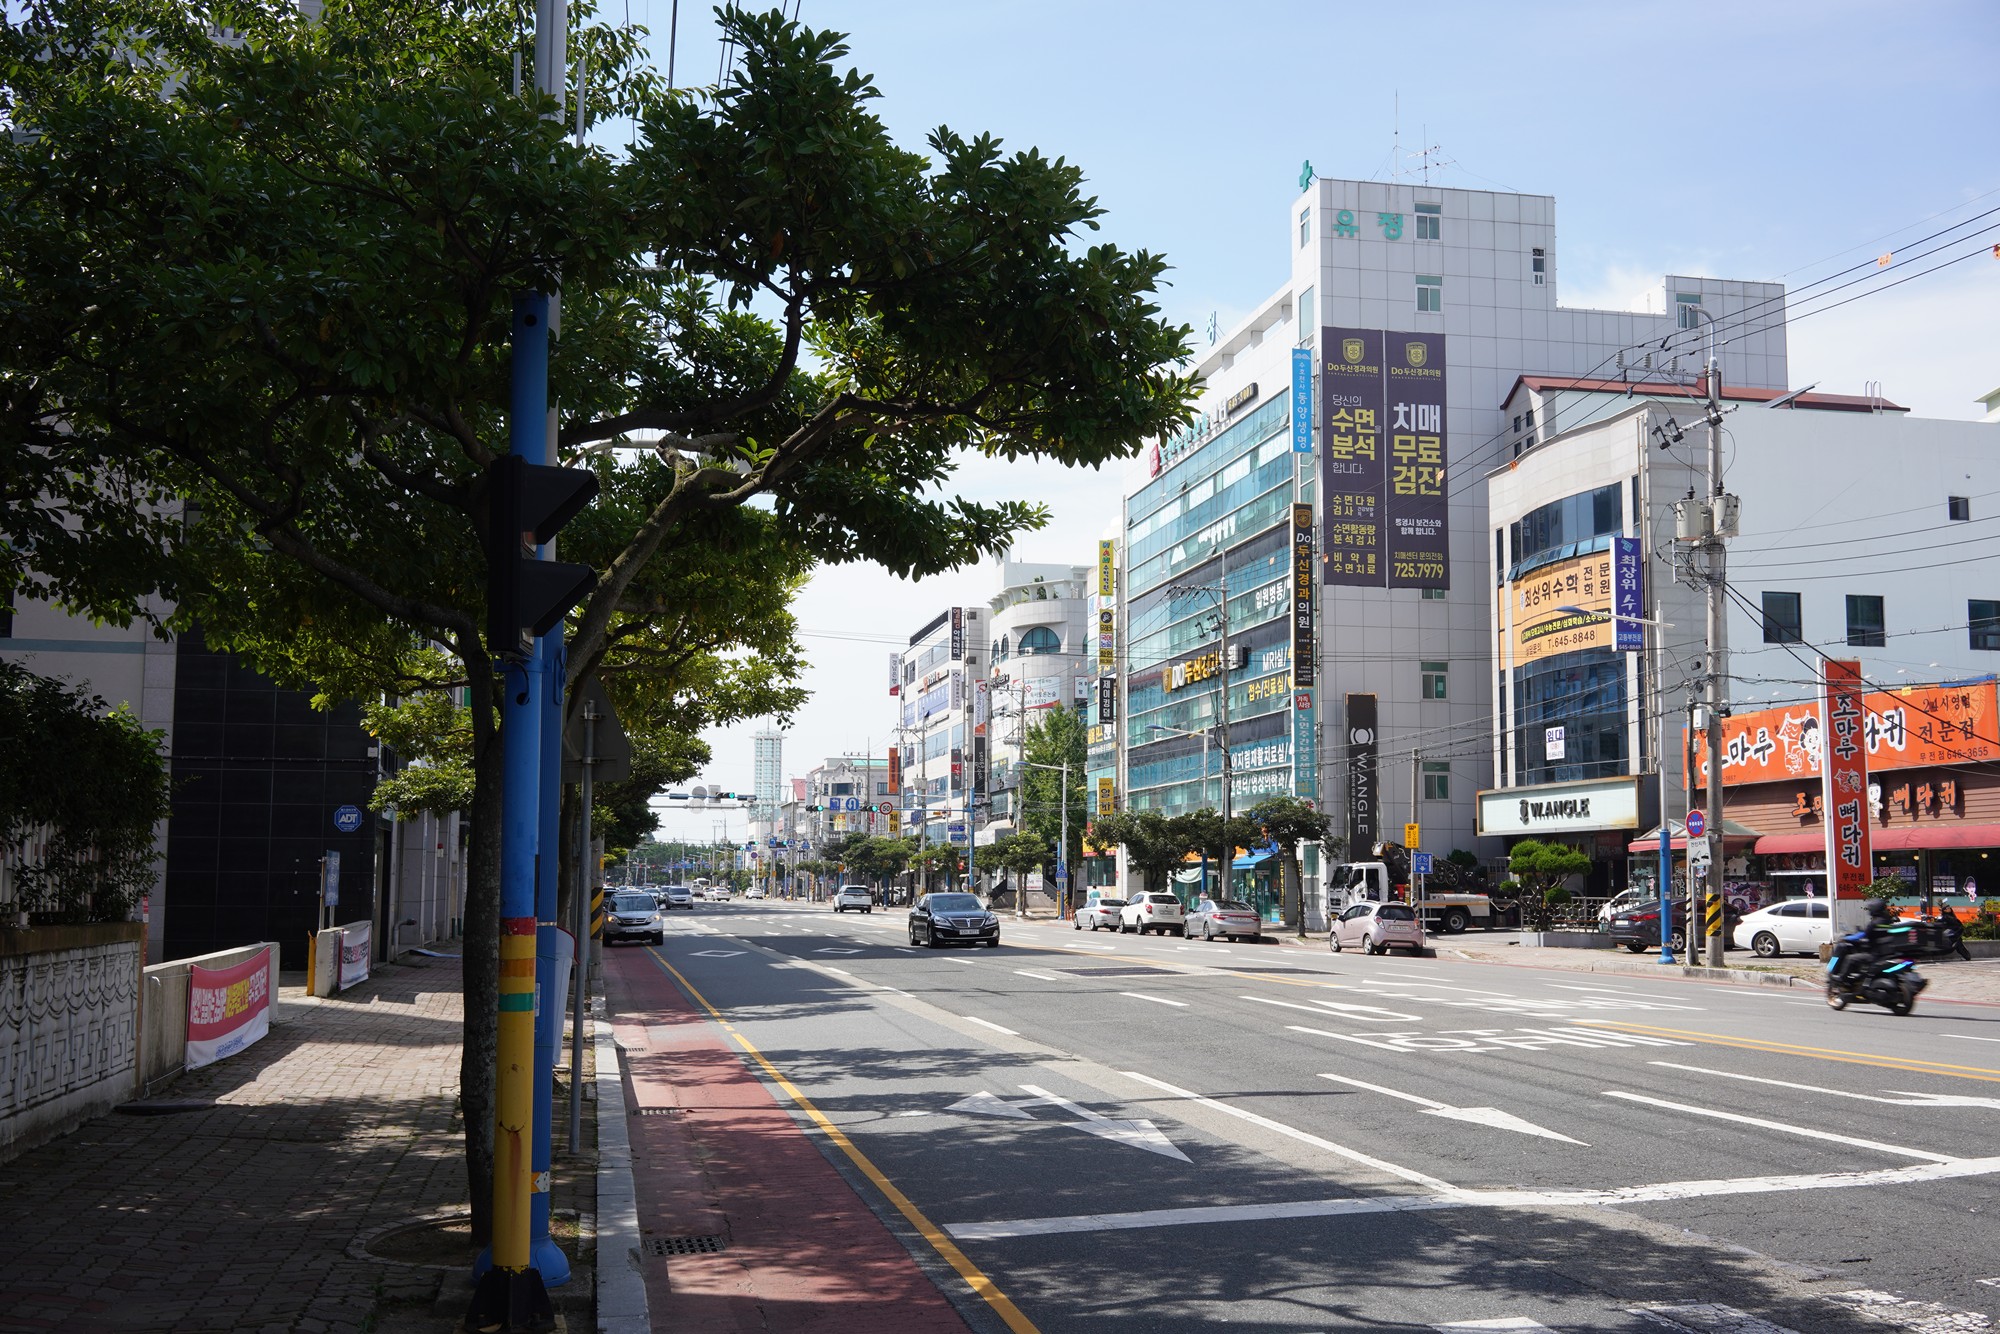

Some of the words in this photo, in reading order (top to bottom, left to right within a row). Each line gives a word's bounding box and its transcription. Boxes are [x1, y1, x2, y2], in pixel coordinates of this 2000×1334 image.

[1333, 395, 1362, 407] 당신의
[1297, 393, 1307, 448] 동양생명
[1393, 402, 1440, 433] 치매
[1332, 434, 1375, 460] 분석
[1393, 435, 1441, 464] 무료
[1333, 462, 1365, 474] 합니다.
[1393, 466, 1441, 495] 검진
[1333, 505, 1353, 516] 검사
[1415, 527, 1437, 536] 합니다.
[1416, 518, 1442, 528] 보건소와
[1296, 533, 1311, 543] Do
[1394, 562, 1444, 579] 725.7979
[1297, 545, 1310, 629] 두신경과의원
[1547, 728, 1564, 742] 임대
[1832, 694, 1860, 761] 조마루
[1919, 717, 1976, 745] 전문점
[1920, 749, 1945, 762] 무전점
[1947, 746, 1989, 760] 646-3655
[1357, 752, 1368, 835] W.ANGLE
[1531, 799, 1590, 819] W.ANGLE
[339, 814, 358, 824] ADT
[1839, 799, 1862, 867] 뼈다귀
[1842, 872, 1865, 881] 무전점
